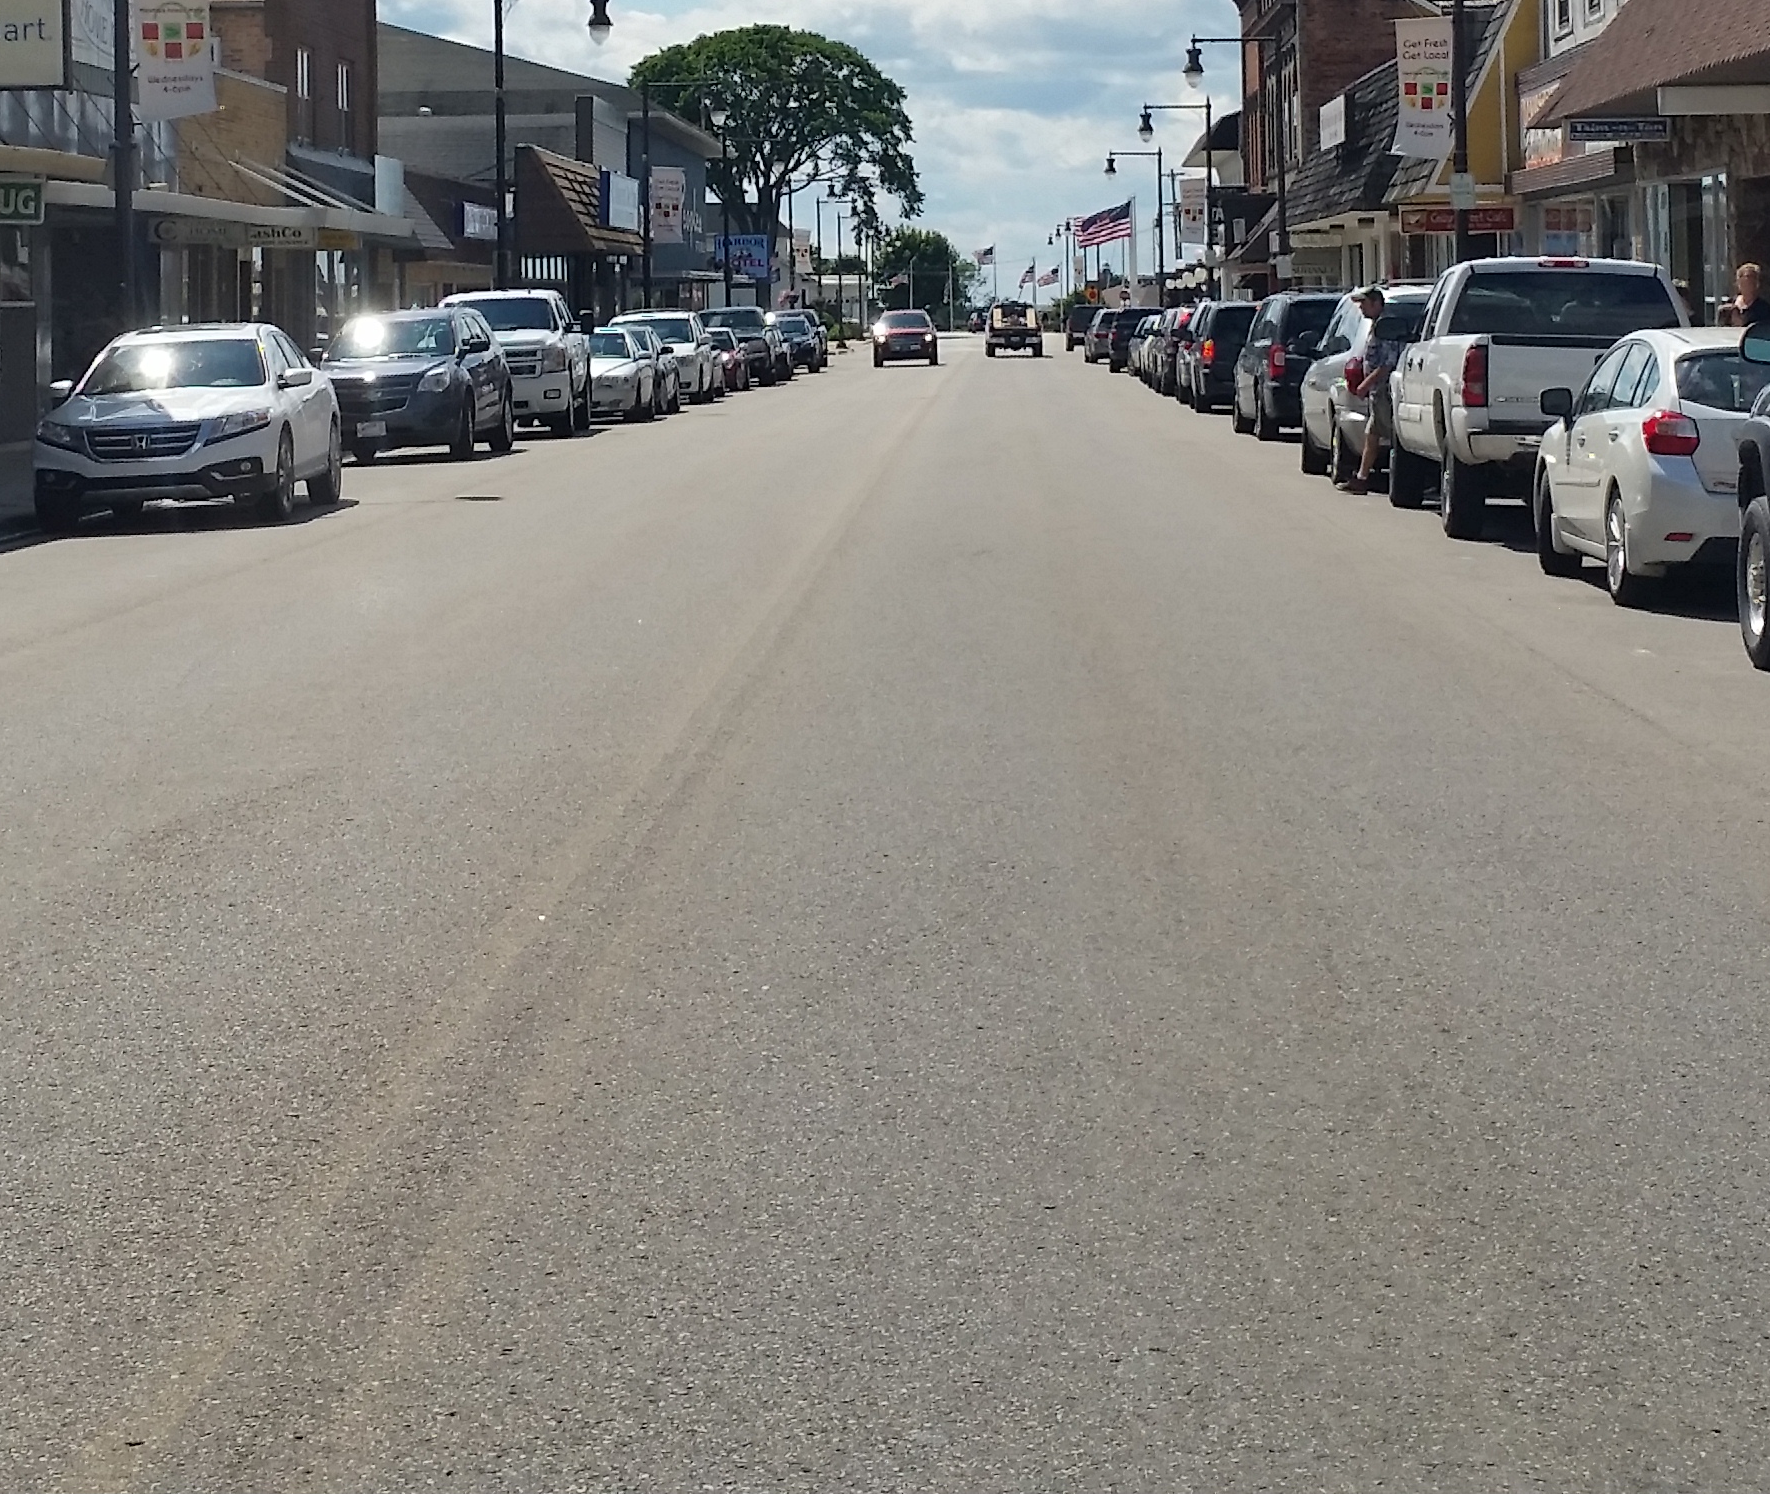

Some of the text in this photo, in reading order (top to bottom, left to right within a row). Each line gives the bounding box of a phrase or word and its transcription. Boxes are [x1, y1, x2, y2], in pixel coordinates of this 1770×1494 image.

[1403, 39, 1421, 48] Get
[1403, 50, 1421, 60] Get
[250, 226, 302, 237] ashCo
[731, 258, 765, 267] OTEL
